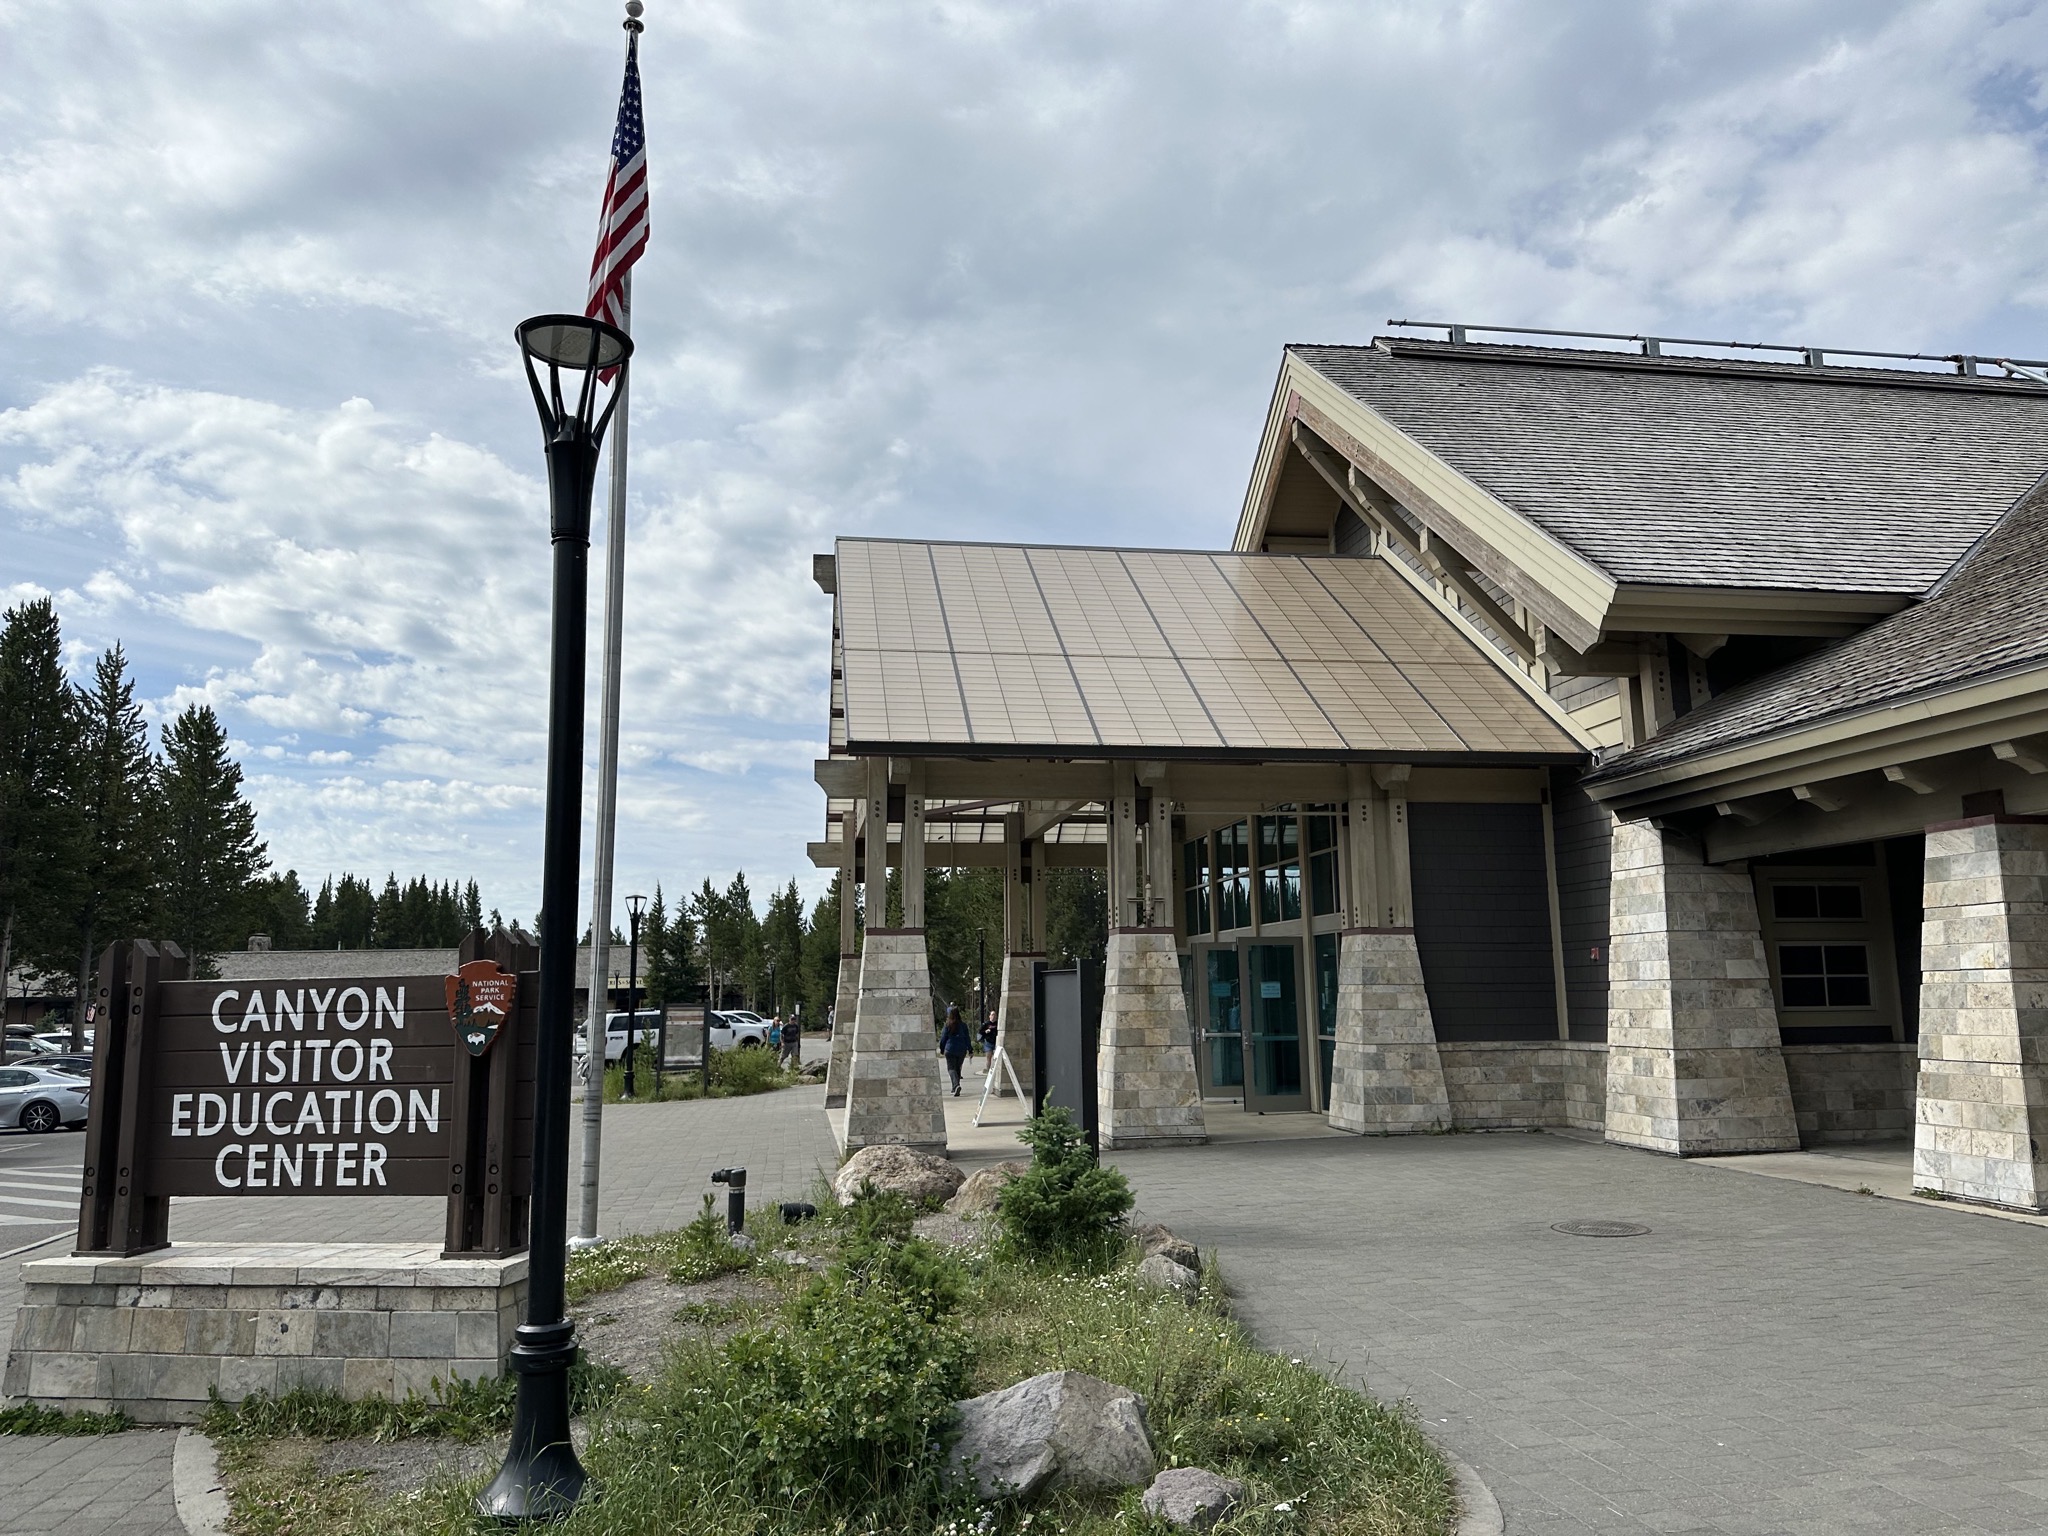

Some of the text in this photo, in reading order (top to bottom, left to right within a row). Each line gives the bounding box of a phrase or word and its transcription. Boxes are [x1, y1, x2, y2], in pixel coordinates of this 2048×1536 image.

[211, 986, 405, 1034] CANYON
[475, 993, 505, 1001] SERVICE
[219, 1038, 394, 1084] VISITOR
[171, 1088, 440, 1137] EDUCATION
[215, 1142, 388, 1188] CENTER
